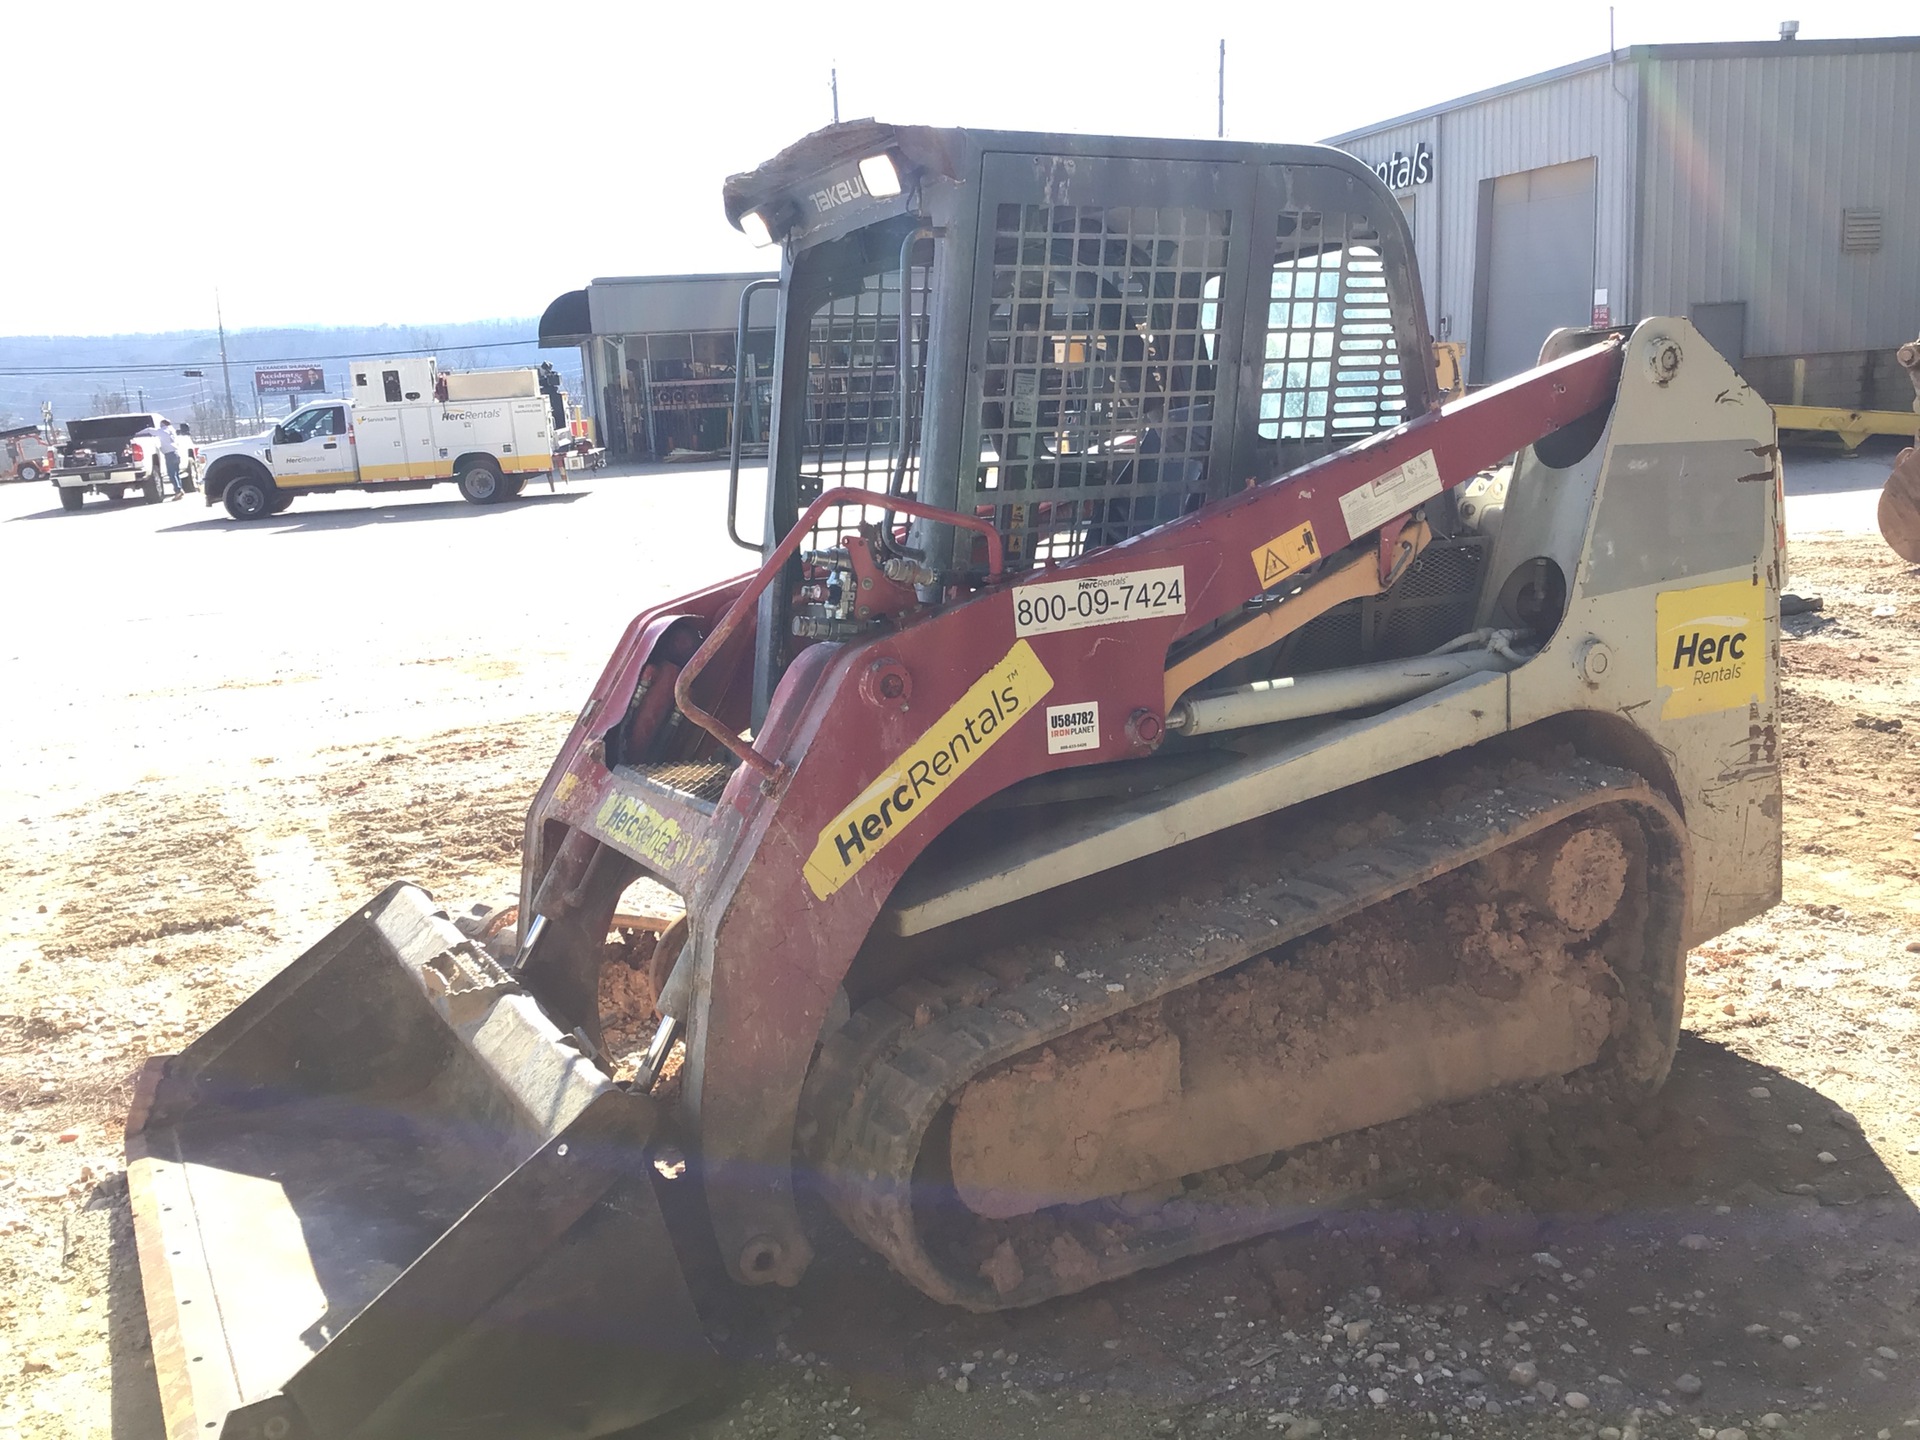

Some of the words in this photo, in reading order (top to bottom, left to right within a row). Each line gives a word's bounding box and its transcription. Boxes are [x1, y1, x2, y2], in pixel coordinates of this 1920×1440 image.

[1368, 142, 1430, 191] ntals
[808, 174, 868, 212] TAKEU
[260, 372, 293, 380] Accident
[260, 378, 285, 387] Injury
[441, 409, 501, 421] HercRentals
[286, 456, 326, 464] HercRentals
[1077, 576, 1127, 591] HercRentals
[1017, 578, 1182, 627] 800-09-7424
[1673, 632, 1748, 671] Herc
[1692, 663, 1742, 686] Rentals
[1050, 710, 1094, 729] U584782
